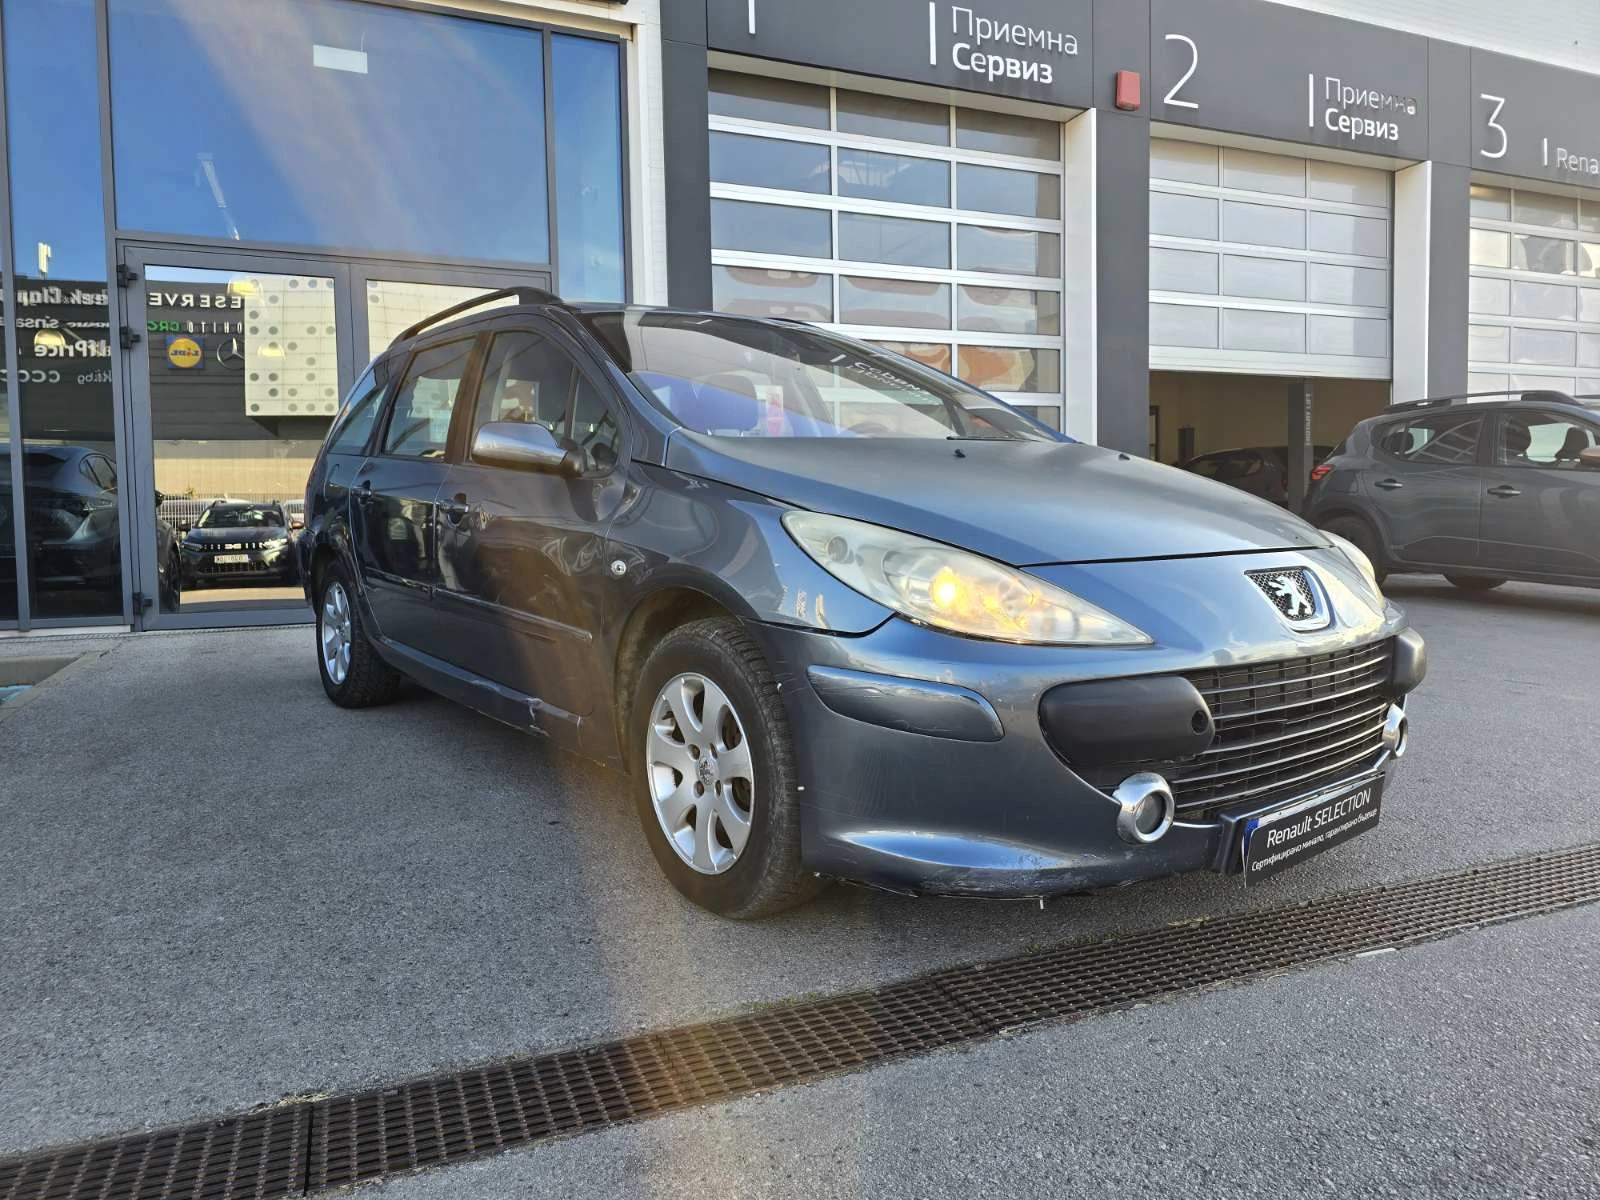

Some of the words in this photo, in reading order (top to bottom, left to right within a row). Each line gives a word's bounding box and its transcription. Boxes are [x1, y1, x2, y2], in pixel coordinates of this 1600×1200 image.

[951, 5, 1078, 55] Приемна
[951, 42, 1054, 84] Сервиз
[1163, 34, 1199, 109] 2
[1324, 76, 1417, 115] Приемна
[1324, 107, 1399, 141] Сервиз
[1479, 93, 1508, 159] 3
[1266, 815, 1313, 849] Renault
[1313, 787, 1372, 830] SELECTION
